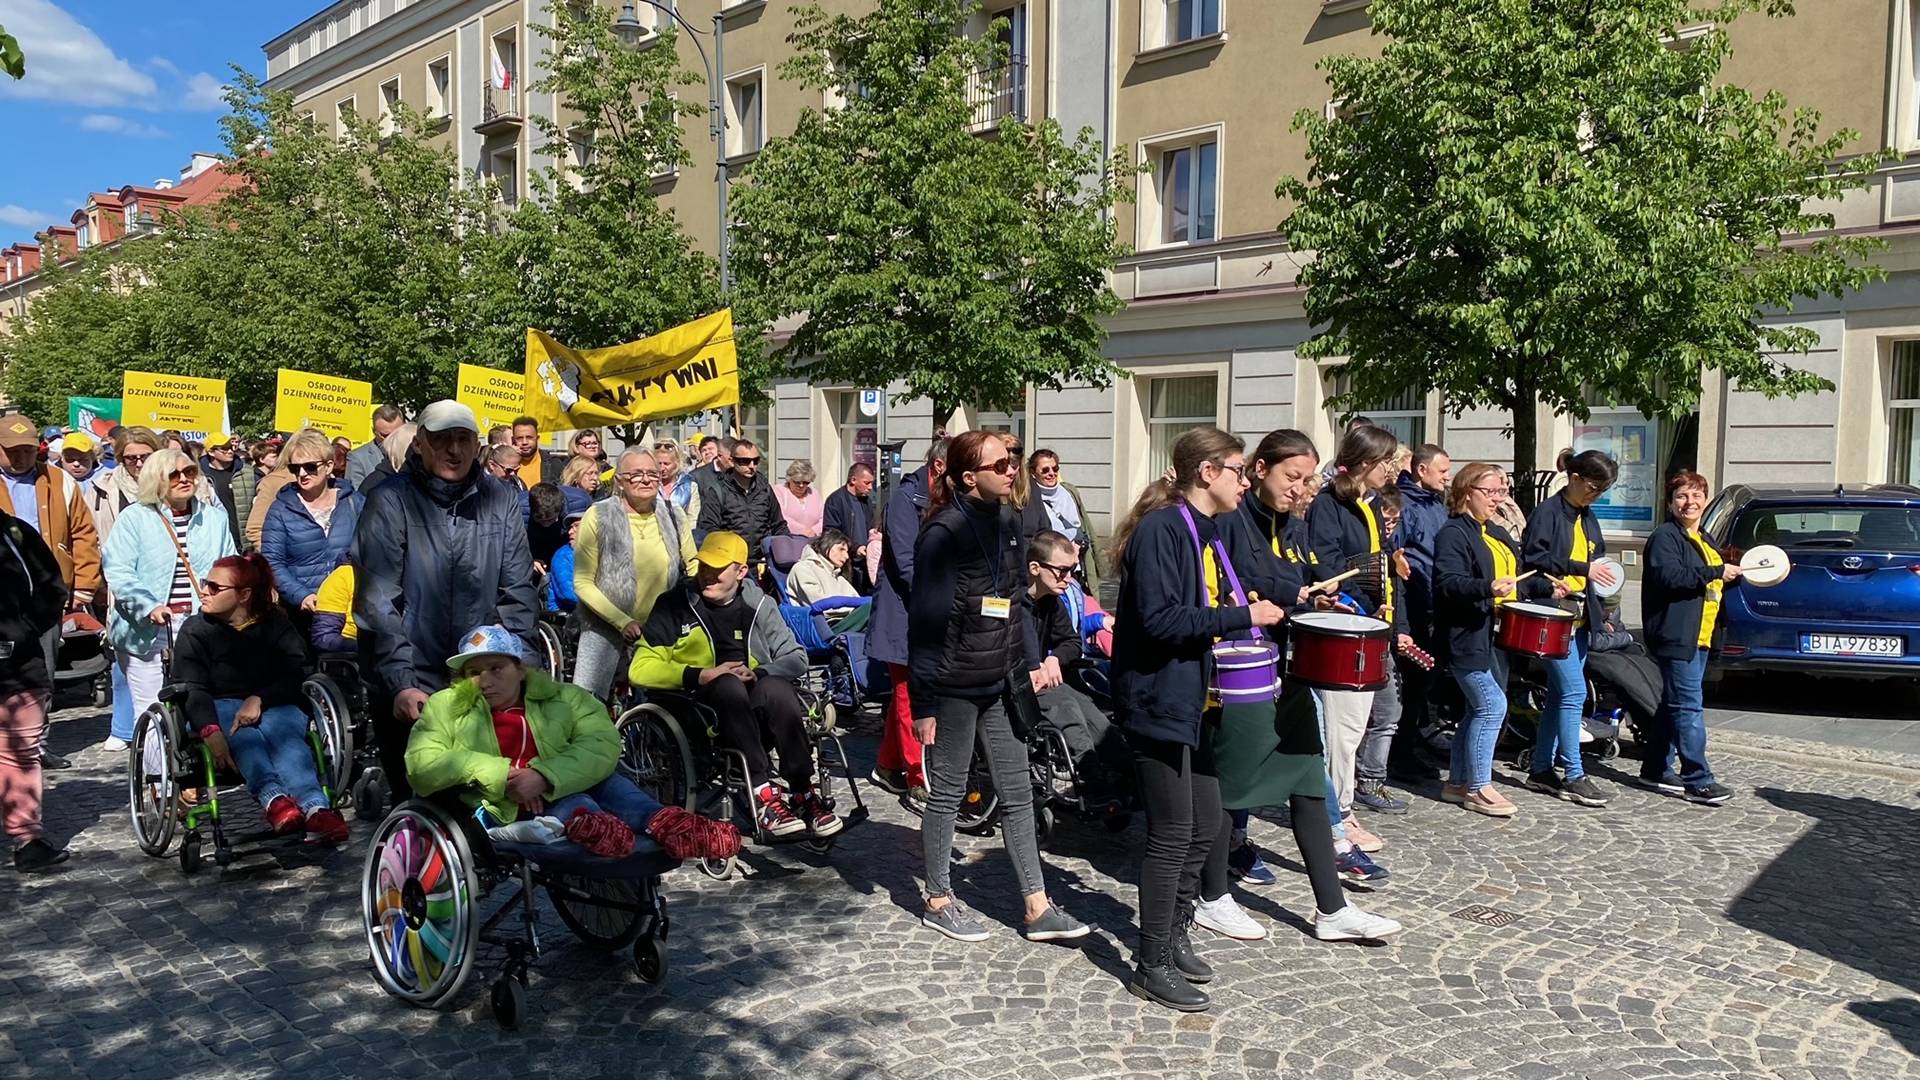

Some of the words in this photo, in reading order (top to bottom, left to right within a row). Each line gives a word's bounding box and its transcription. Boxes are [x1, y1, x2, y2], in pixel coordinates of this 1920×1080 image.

[154, 381, 198, 391] OŚRODEK
[307, 381, 347, 393] OŚRODEK
[489, 377, 525, 391] OŚRODE
[127, 388, 184, 400] DZIENNEGO
[185, 393, 221, 403] POBYTU
[283, 388, 335, 402] DZIENNEGO
[336, 396, 367, 407] POBYTU
[464, 385, 516, 401] DZIENNEGO
[159, 401, 190, 410] Witosa
[310, 403, 342, 414] Staszica
[484, 401, 524, 413] Hetmańsk
[1811, 634, 1842, 650] BIA
[1848, 636, 1899, 653] 97839
